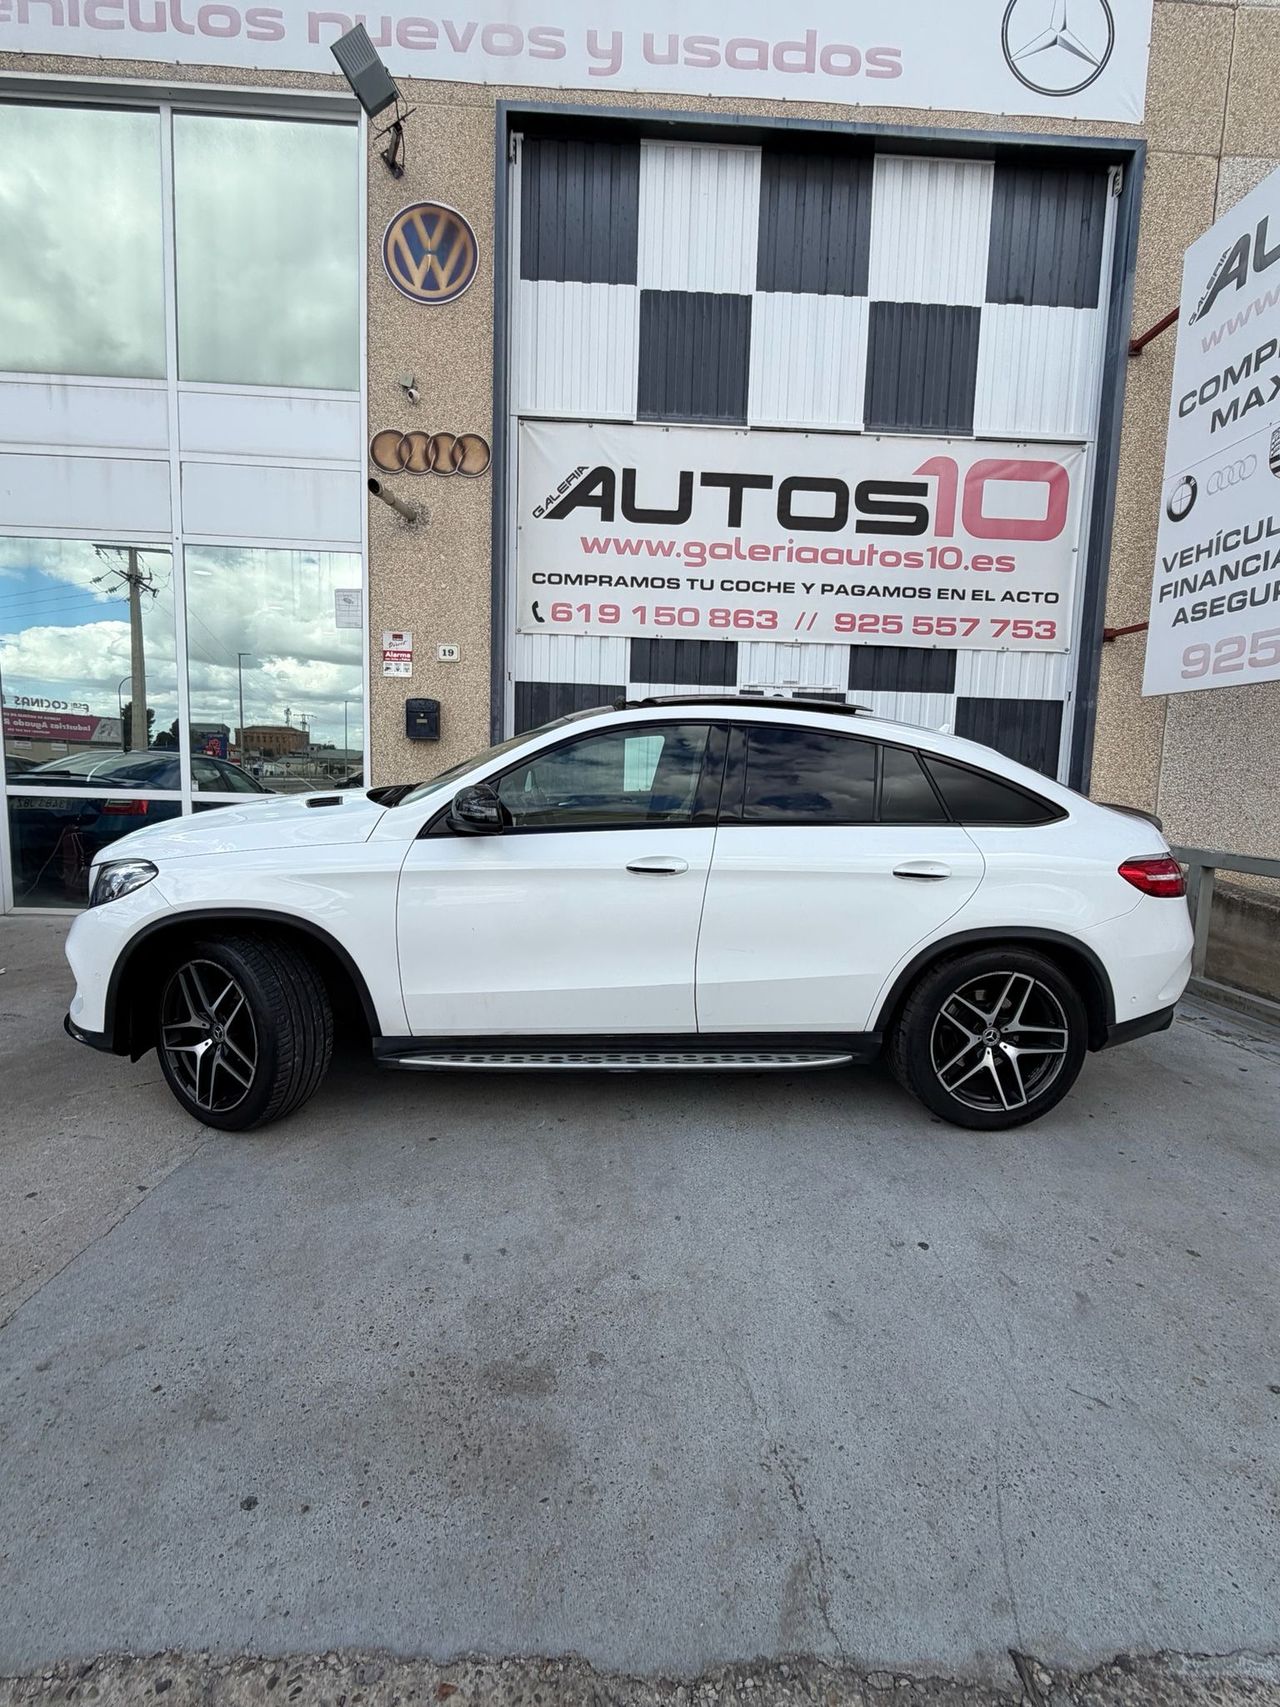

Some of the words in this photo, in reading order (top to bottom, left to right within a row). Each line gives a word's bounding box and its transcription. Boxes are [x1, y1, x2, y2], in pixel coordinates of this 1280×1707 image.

[308, 11, 567, 60] nuevos
[586, 29, 623, 76] y
[643, 29, 903, 79] usados
[1179, 338, 1280, 418] COMP
[532, 465, 590, 519] GALERIA
[580, 536, 1016, 573] www.galeriaautos10.es
[532, 572, 680, 590] COMPRAMOS
[686, 578, 715, 592] TU
[720, 580, 795, 594] COCHE
[801, 582, 816, 595] Y
[821, 583, 931, 599] PAGAMOS
[937, 588, 966, 601] EN
[971, 589, 996, 602] EL
[1000, 591, 1059, 604] ACTO
[551, 602, 621, 624] 619
[632, 605, 700, 627] 150
[709, 608, 778, 630] 863
[834, 612, 903, 634] 925
[912, 615, 981, 637] 557
[990, 618, 1057, 640] 753
[442, 649, 454, 657] 19
[1181, 627, 1280, 680] 925
